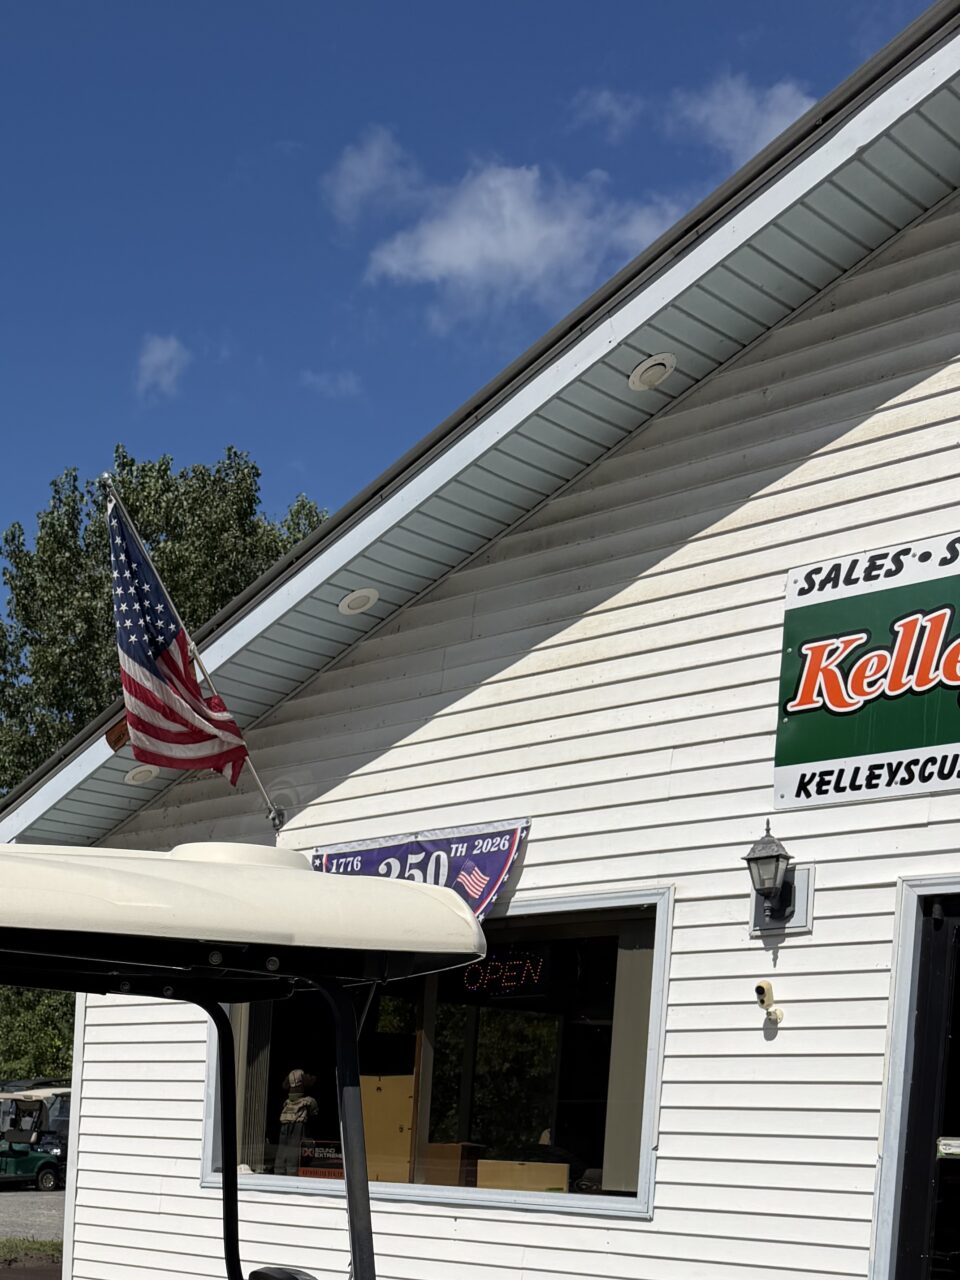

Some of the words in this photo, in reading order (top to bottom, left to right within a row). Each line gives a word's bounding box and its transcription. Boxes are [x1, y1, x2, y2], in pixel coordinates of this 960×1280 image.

[797, 548, 912, 597] SALES
[795, 754, 960, 799] KELLEYSCU
[331, 856, 362, 873] 1776
[472, 834, 510, 855] 2026
[464, 958, 543, 991] OPEN
